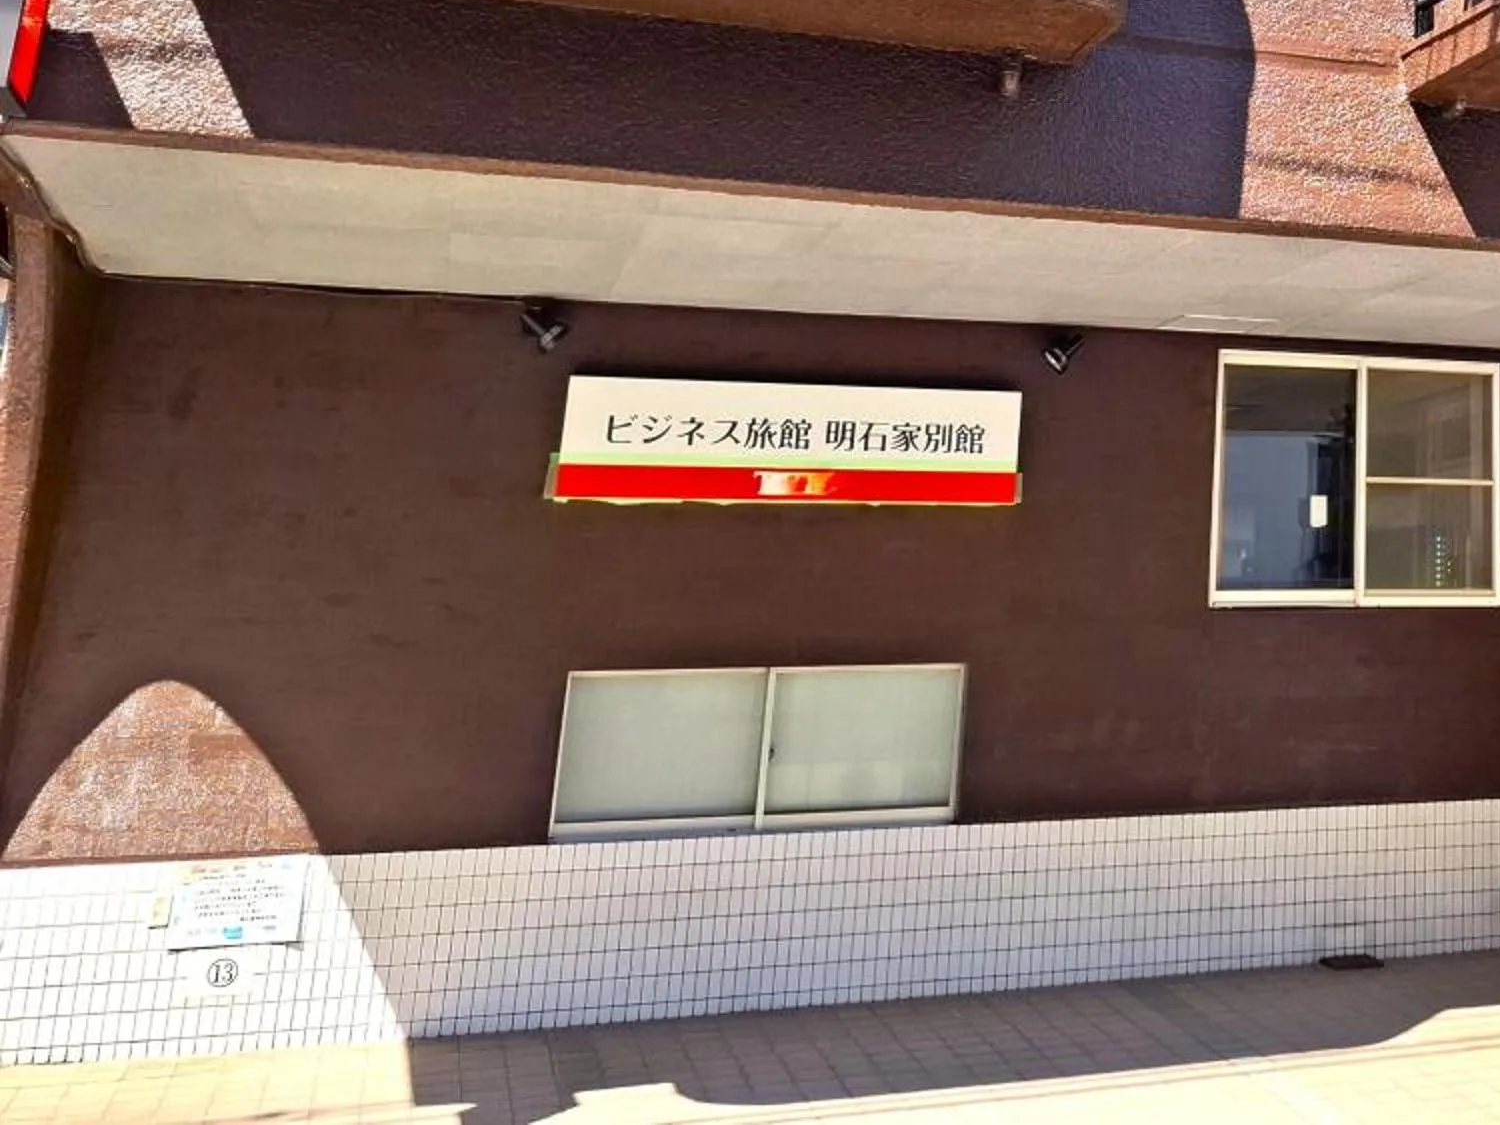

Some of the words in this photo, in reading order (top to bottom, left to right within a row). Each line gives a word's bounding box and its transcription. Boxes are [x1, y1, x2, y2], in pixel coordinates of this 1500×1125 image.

[606, 414, 812, 450] ビジネス旅館
[825, 420, 985, 454] 明石家別館
[211, 962, 234, 983] 13
